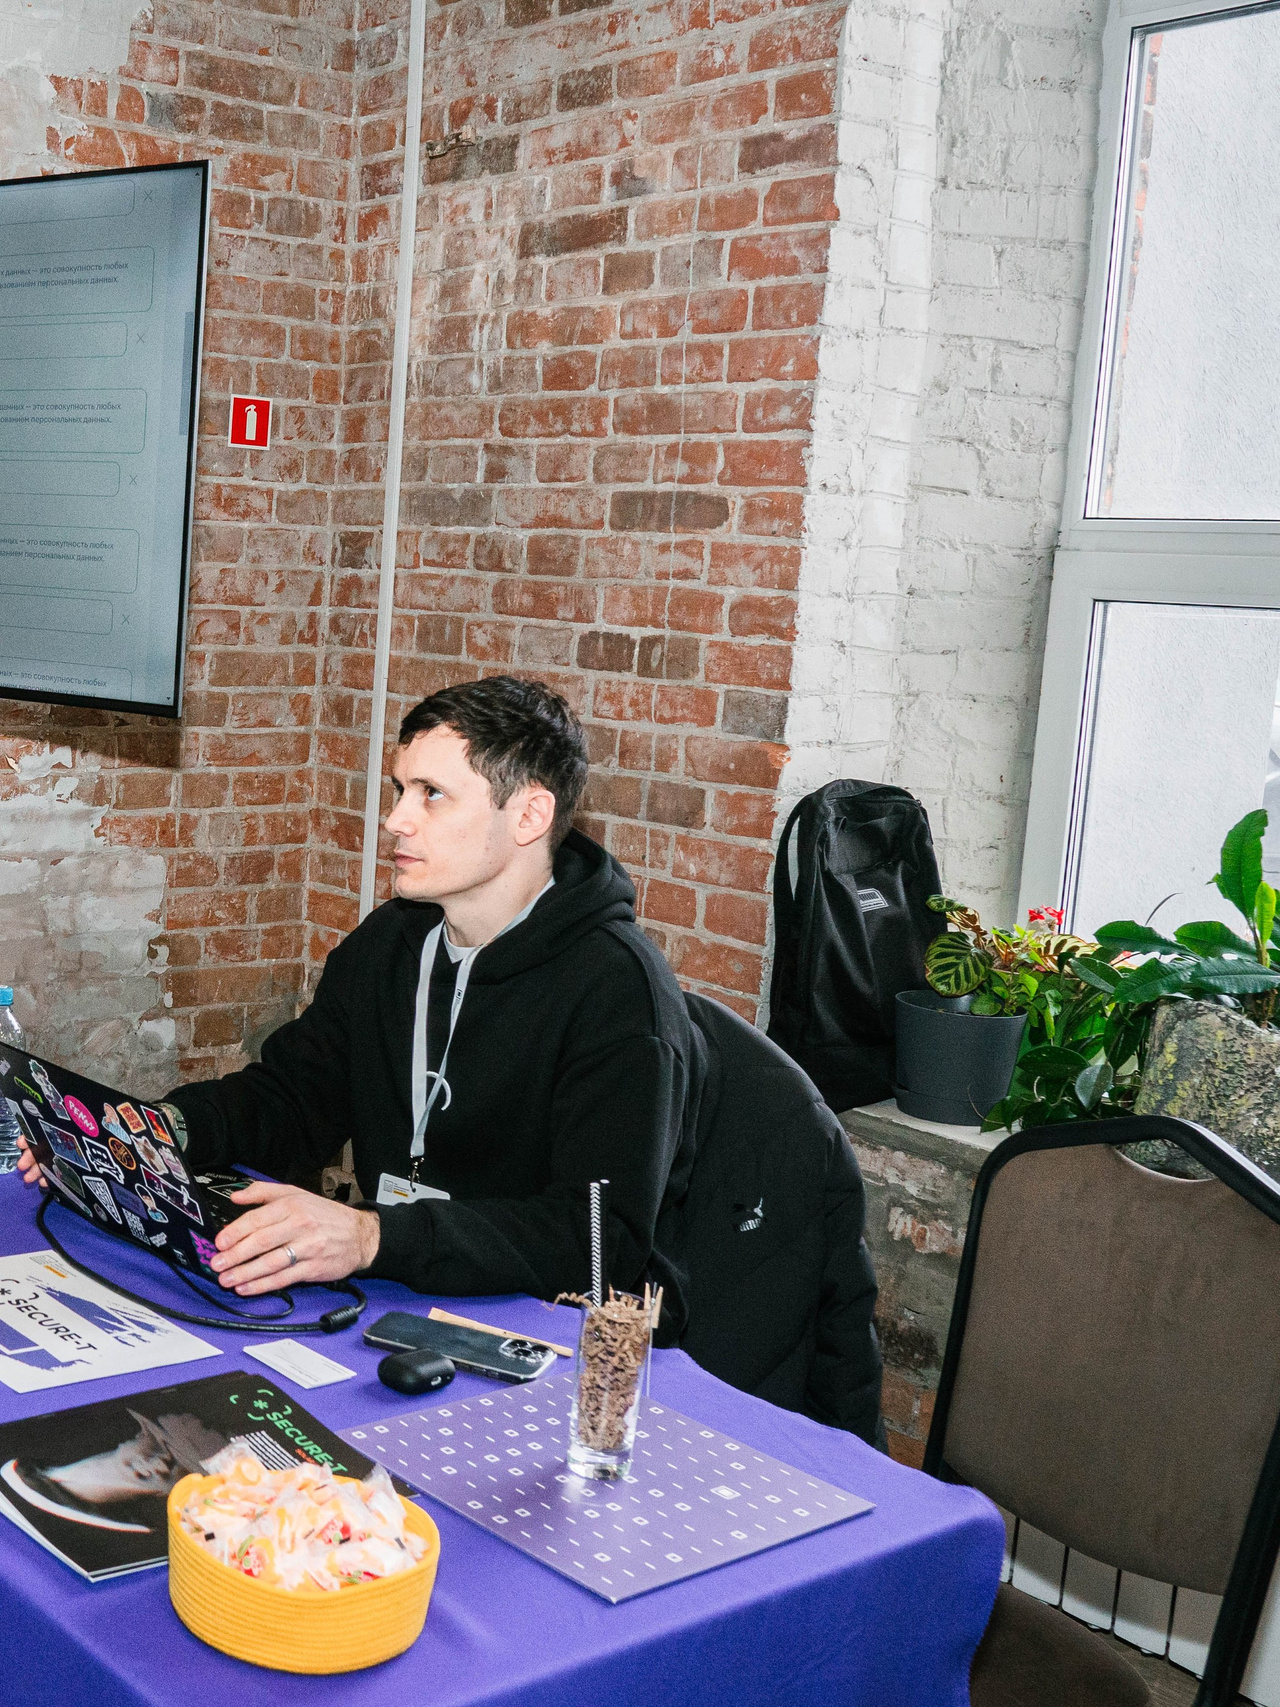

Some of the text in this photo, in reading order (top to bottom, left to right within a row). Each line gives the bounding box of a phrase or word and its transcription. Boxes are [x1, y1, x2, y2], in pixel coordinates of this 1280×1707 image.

[5, 268, 30, 276] данных
[52, 264, 102, 273] совокупность
[103, 260, 128, 269] любых
[96, 401, 121, 409] любых
[89, 540, 113, 548] любых
[68, 1100, 95, 1131] PENNY
[8, 1298, 98, 1352] SECURE-T
[266, 1411, 348, 1473] SECURE-T
